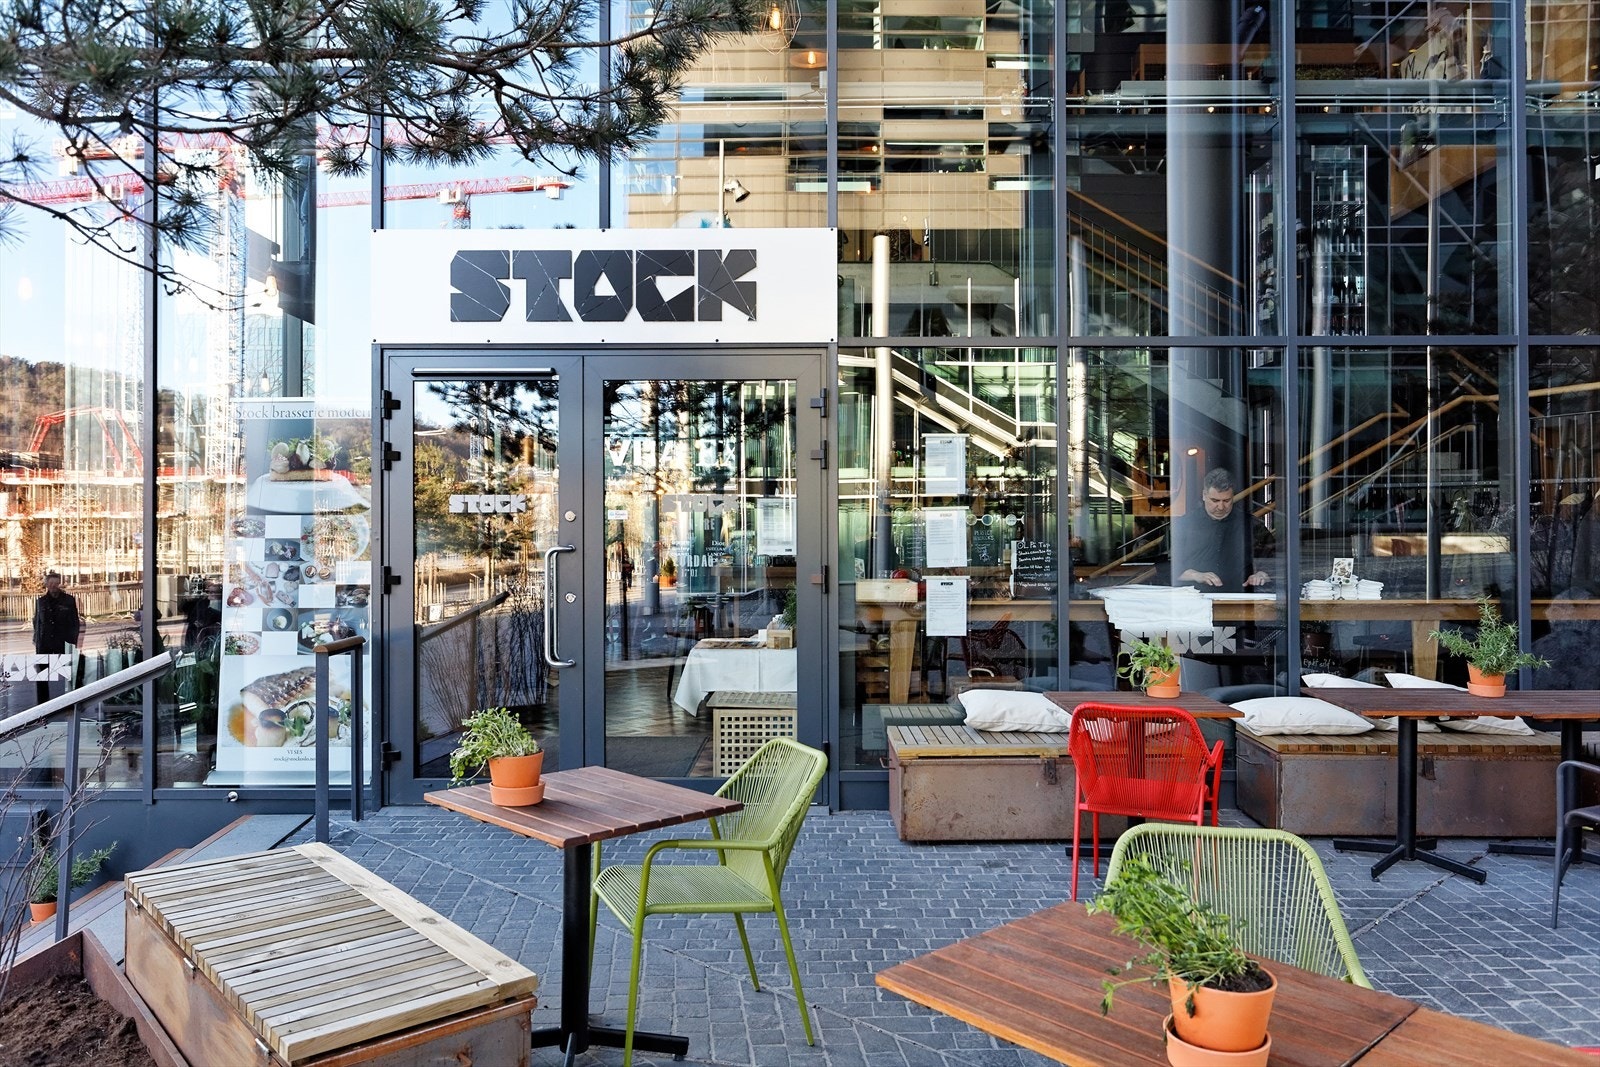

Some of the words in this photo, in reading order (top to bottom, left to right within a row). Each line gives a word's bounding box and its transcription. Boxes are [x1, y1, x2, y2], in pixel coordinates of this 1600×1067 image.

[450, 249, 757, 322] STOCK
[236, 405, 269, 418] Stock
[272, 405, 324, 418] brasserie
[449, 494, 527, 513] STOCK
[0, 654, 72, 681] OCK
